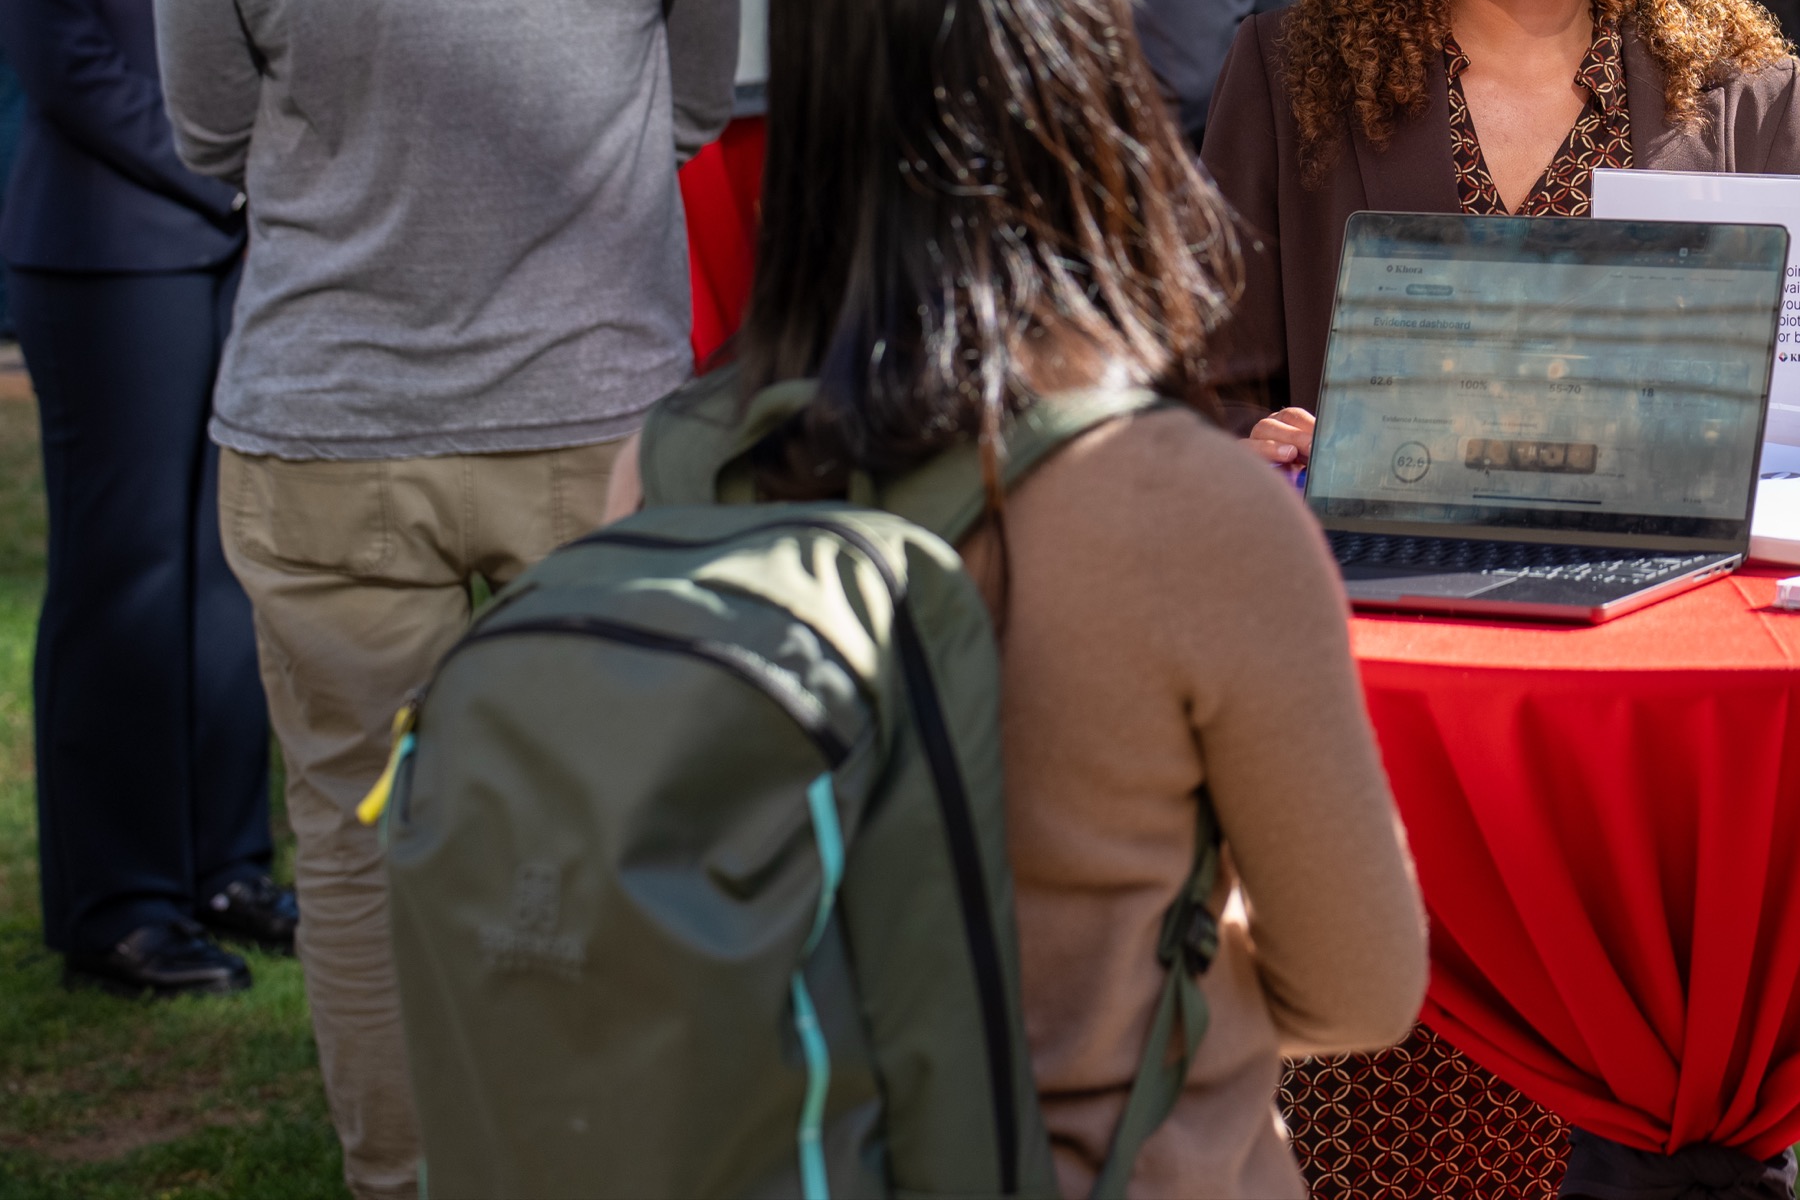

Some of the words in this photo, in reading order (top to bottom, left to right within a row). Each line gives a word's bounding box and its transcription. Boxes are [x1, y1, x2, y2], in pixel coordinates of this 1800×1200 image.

[1395, 265, 1423, 274] Khora
[1373, 316, 1418, 328] Evidence
[1419, 317, 1471, 330] dashboard
[1777, 332, 1791, 343] or
[1370, 376, 1393, 386] 62.6
[1459, 379, 1488, 390] 100%
[1397, 456, 1425, 468] 62.6
